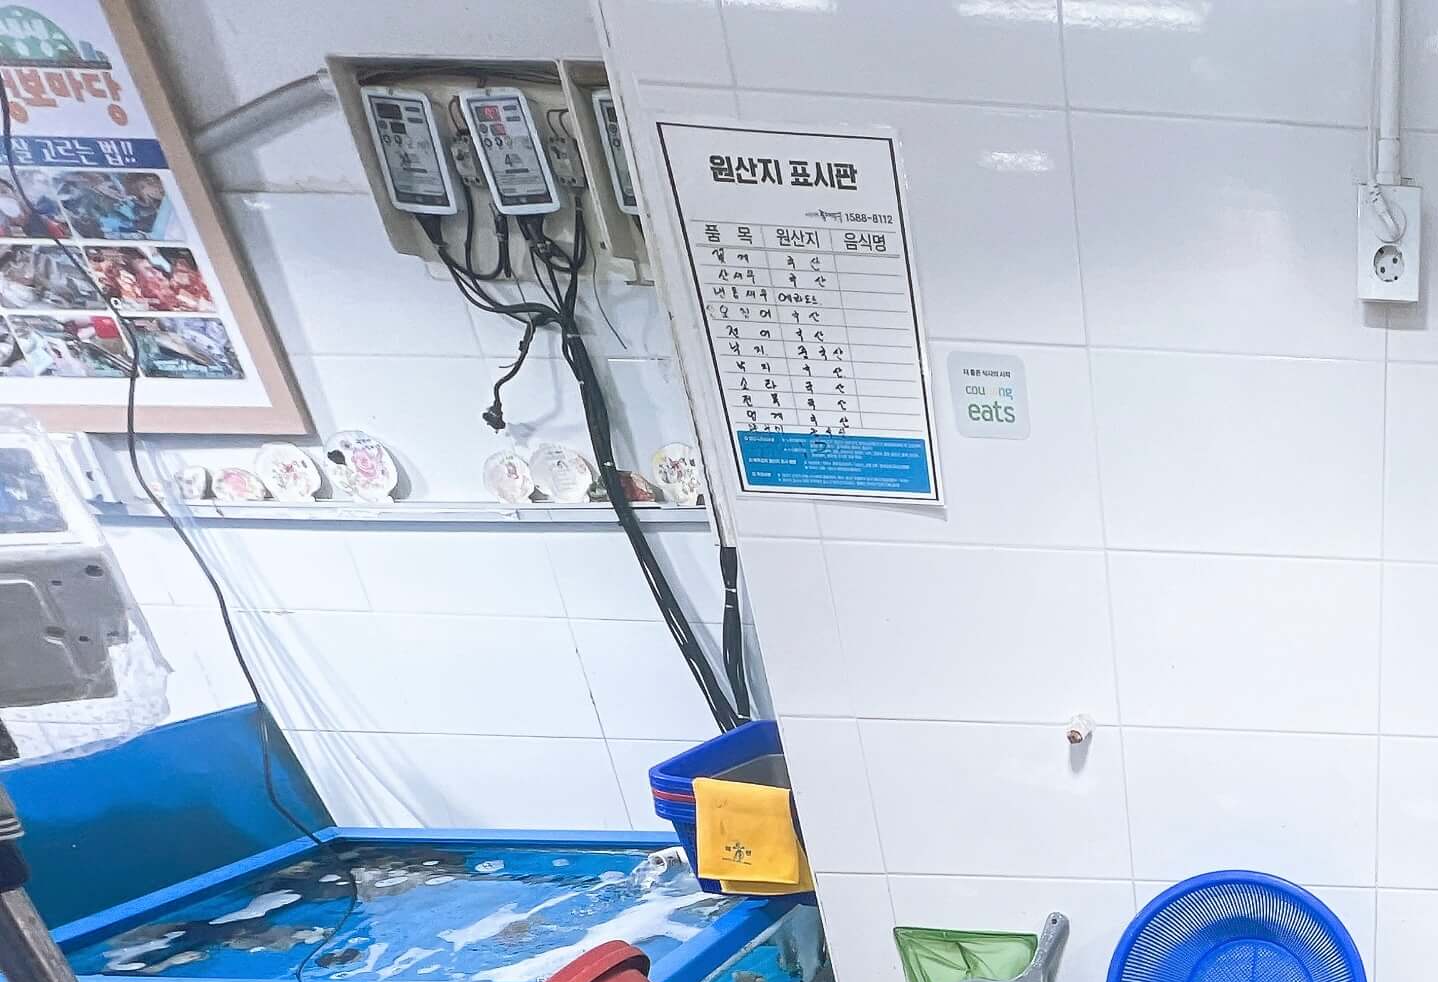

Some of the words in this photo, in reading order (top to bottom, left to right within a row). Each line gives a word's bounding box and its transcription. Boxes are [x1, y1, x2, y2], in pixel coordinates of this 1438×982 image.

[36, 139, 98, 165] 고르는
[709, 154, 783, 186] 원산지
[788, 159, 858, 191] 표시판
[845, 212, 894, 224] 1588-8112
[776, 228, 820, 249] 원산지
[843, 232, 887, 253] 음식명
[968, 400, 1016, 424] eats
